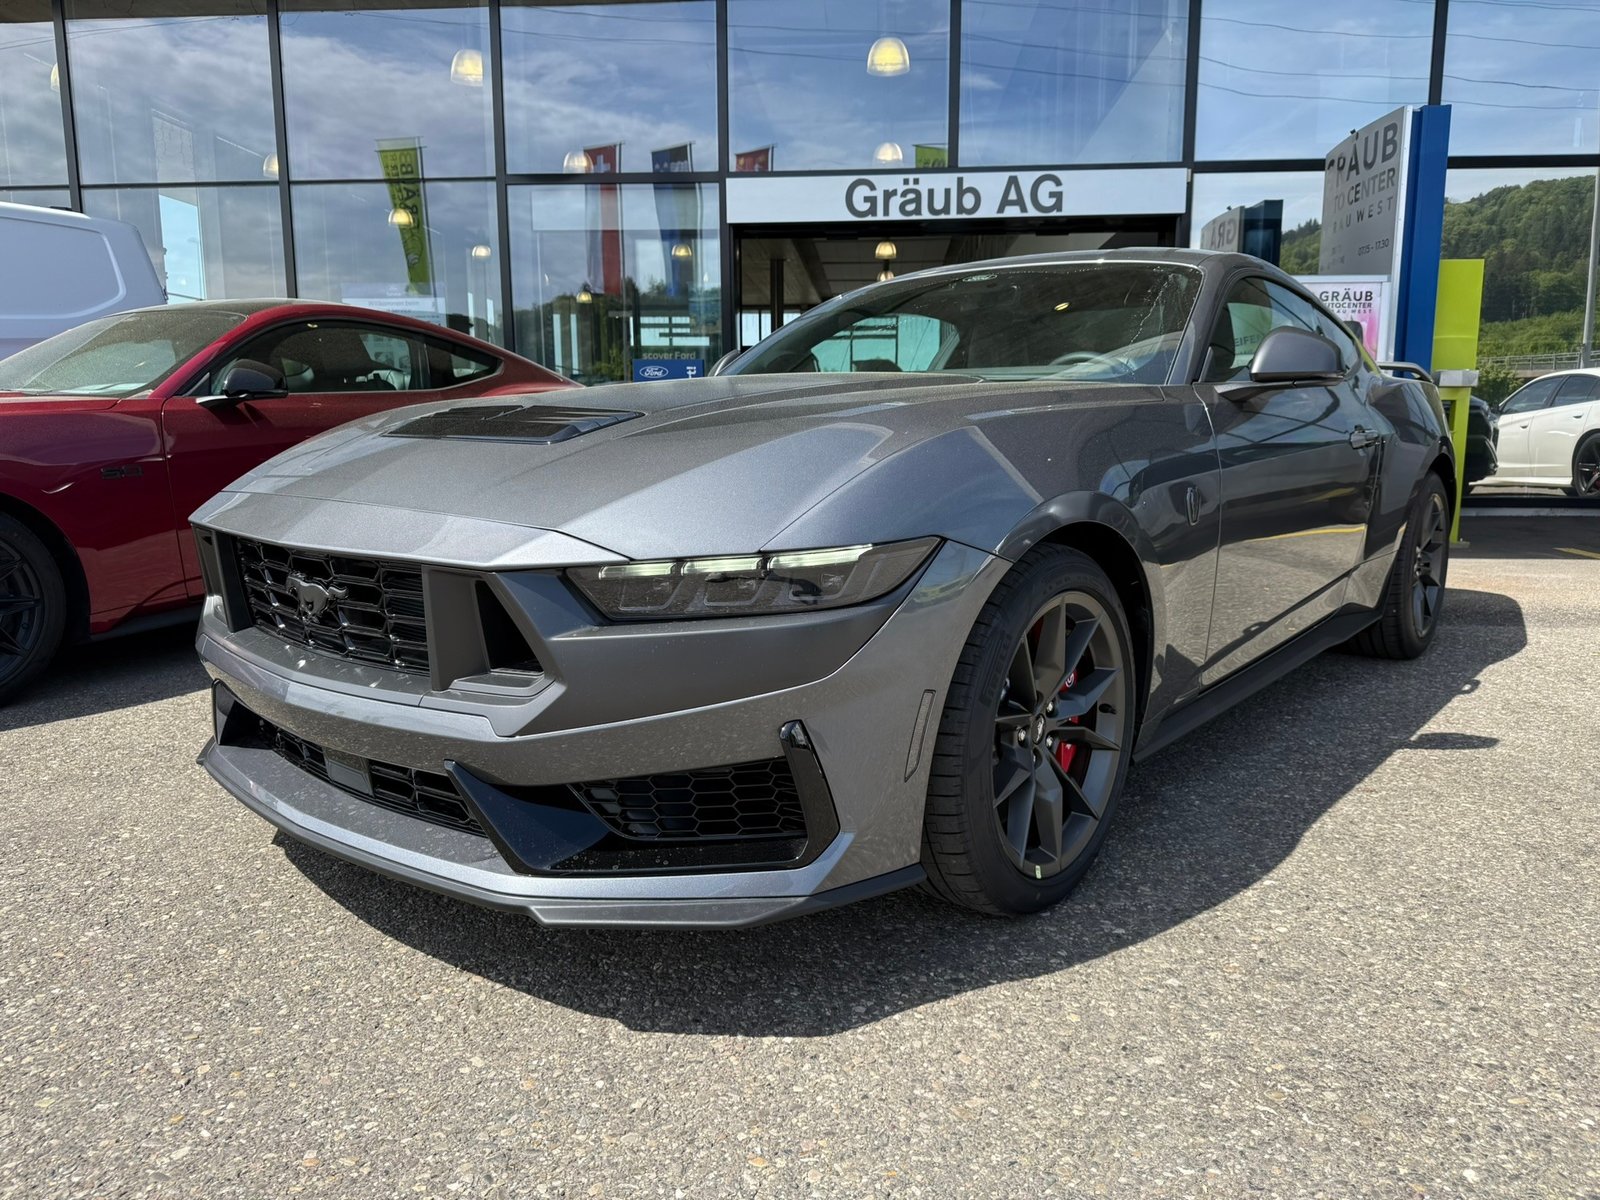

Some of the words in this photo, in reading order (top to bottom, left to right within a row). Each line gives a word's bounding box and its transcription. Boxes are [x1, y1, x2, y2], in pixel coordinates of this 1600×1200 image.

[1327, 122, 1398, 188] RÄUB
[845, 177, 982, 218] Gräub
[996, 173, 1064, 214] AG
[1356, 196, 1394, 223] WEST
[1320, 288, 1373, 302] GRÄUB
[674, 351, 696, 360] Ford
[644, 366, 664, 377] Ford
